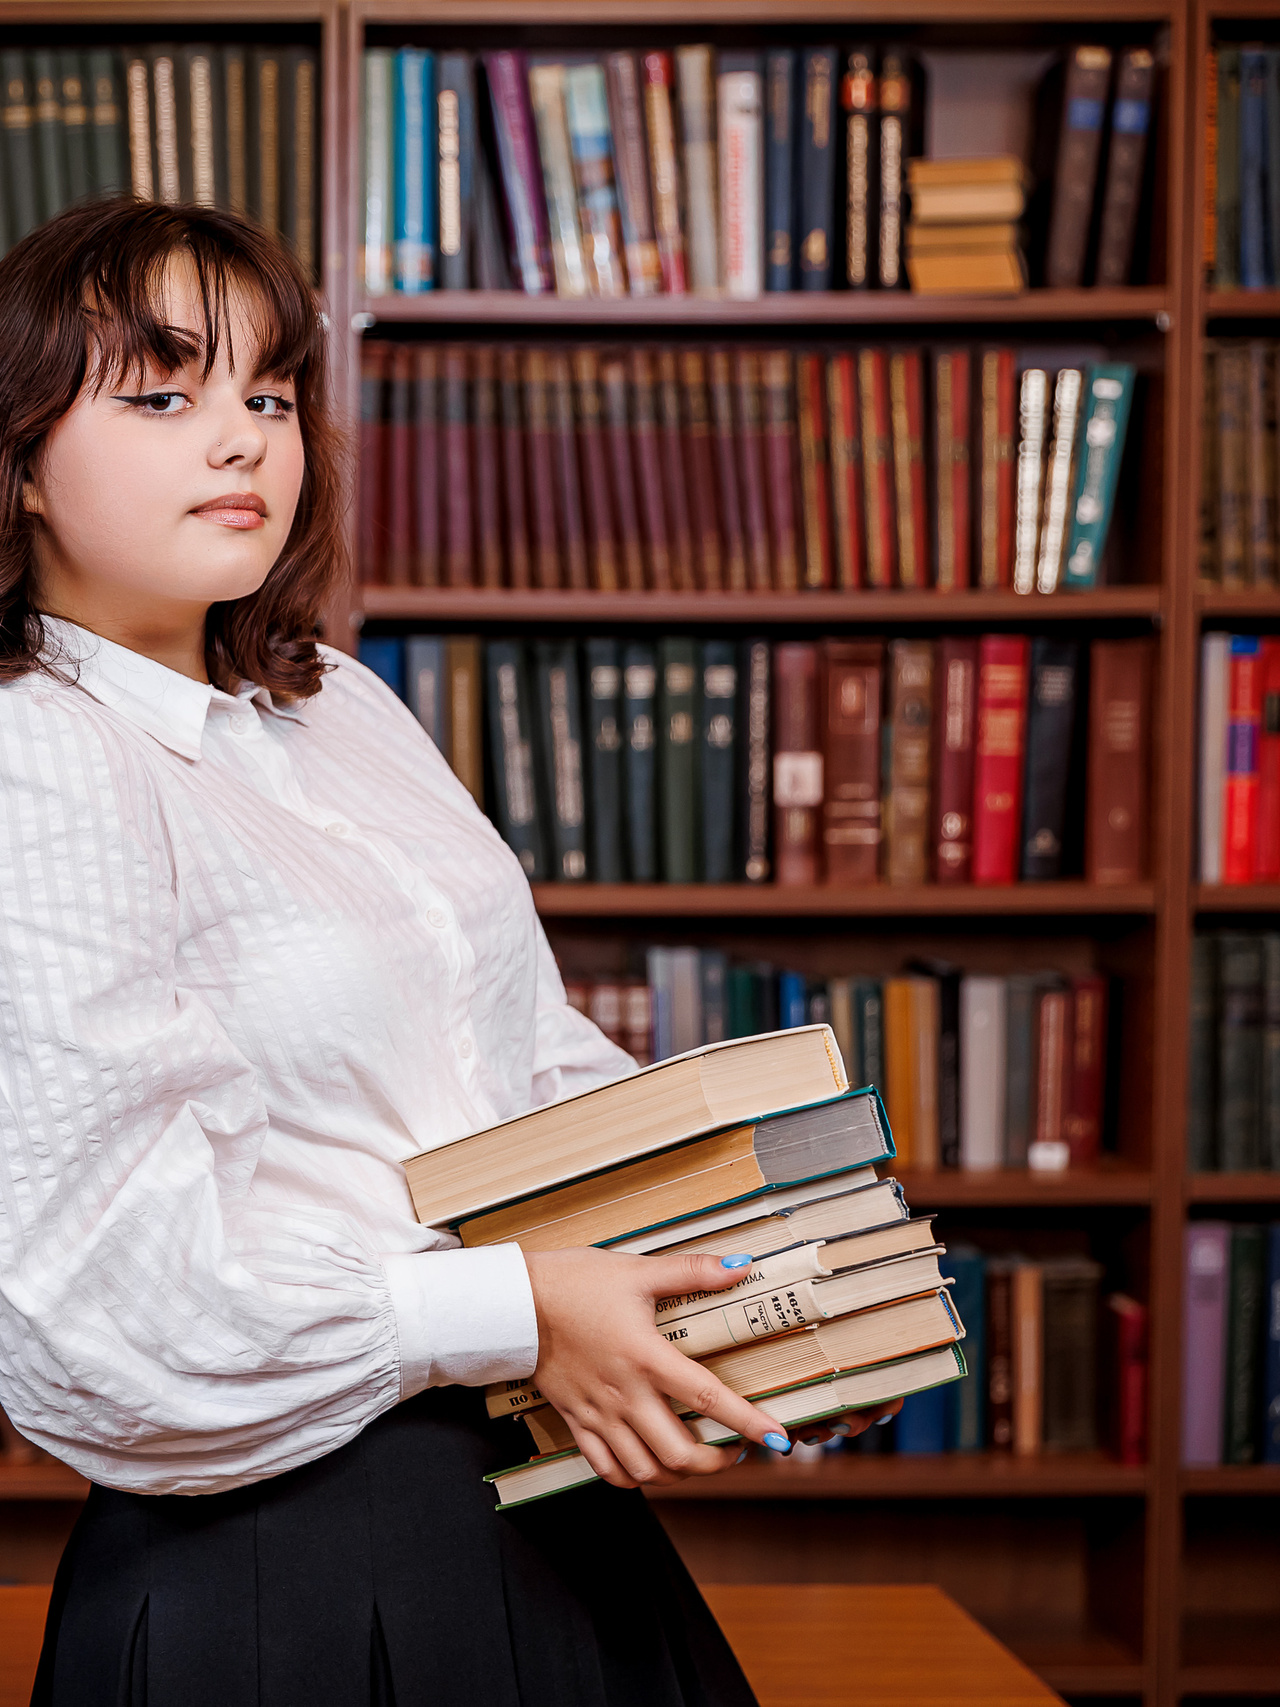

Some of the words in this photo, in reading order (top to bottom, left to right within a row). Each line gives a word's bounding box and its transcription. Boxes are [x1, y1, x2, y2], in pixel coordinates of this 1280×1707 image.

[656, 1296, 683, 1313] ОРИЯ
[770, 1295, 790, 1328] 1870
[785, 1290, 806, 1324] 1640
[750, 1316, 760, 1326] 1
[758, 1305, 770, 1331] ЧАСТЬ
[509, 1394, 529, 1407] ПО
